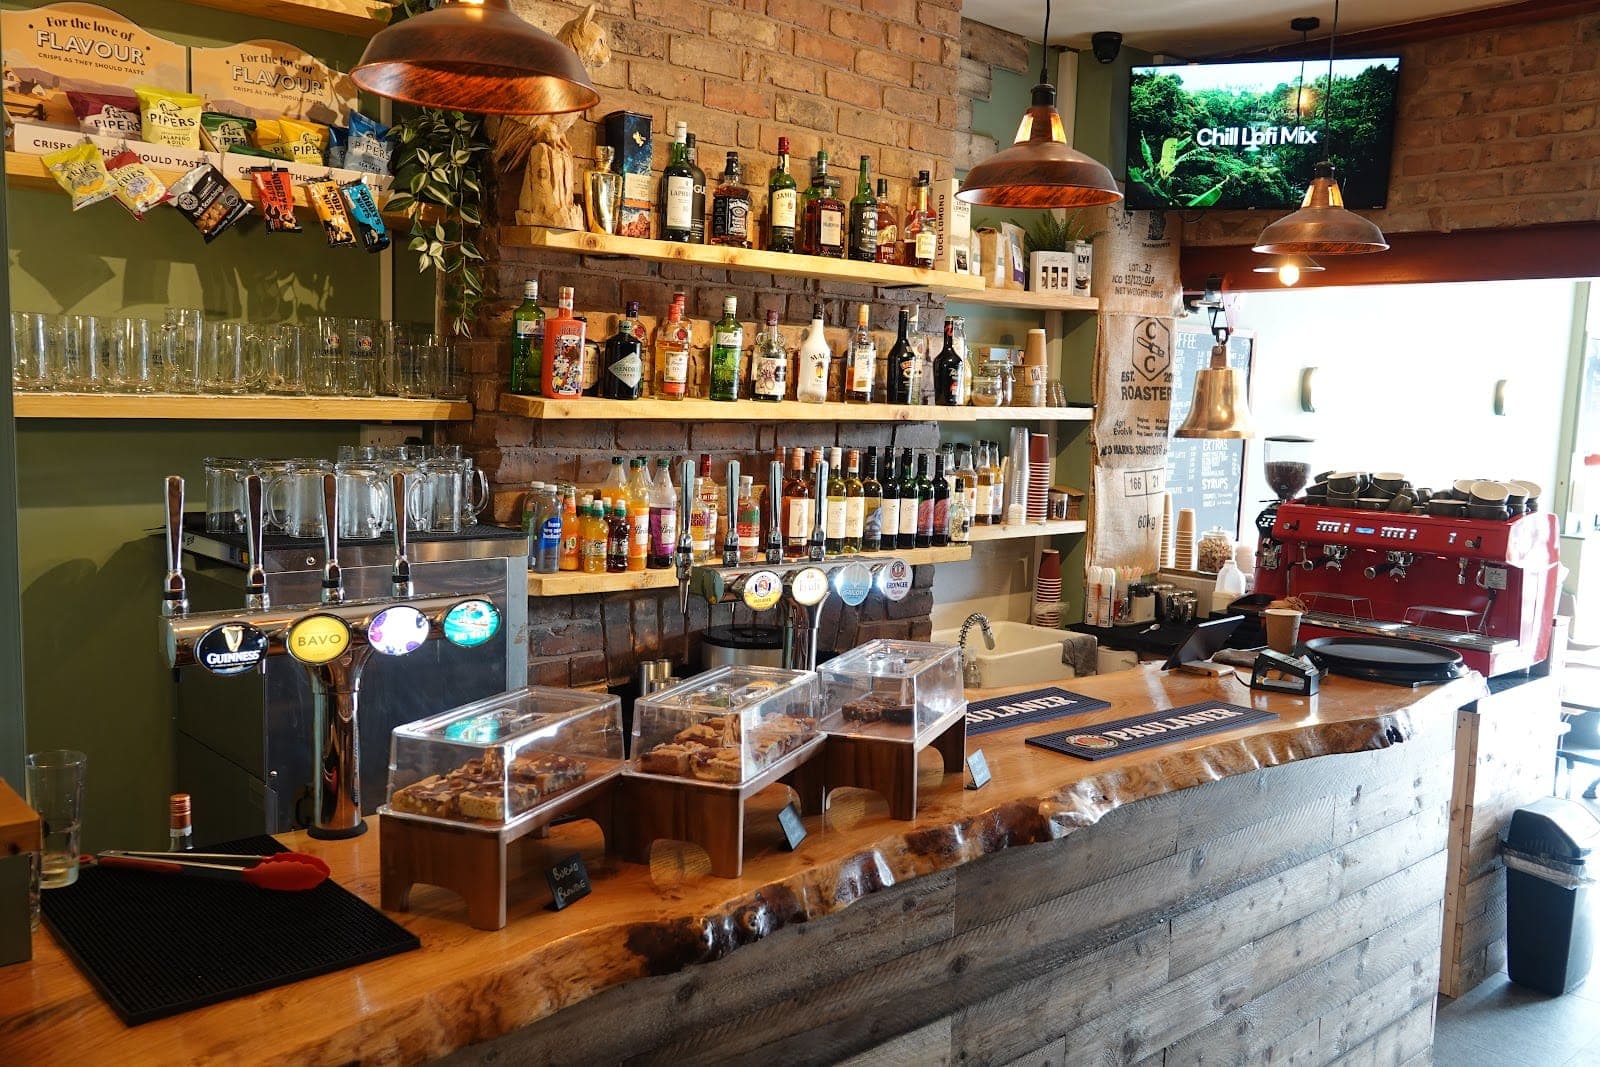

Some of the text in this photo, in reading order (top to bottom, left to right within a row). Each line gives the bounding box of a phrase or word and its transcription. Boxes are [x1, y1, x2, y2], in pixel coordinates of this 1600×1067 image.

[46, 16, 134, 42] For the love of
[37, 30, 145, 66] FLAVOUR
[38, 53, 62, 62] CRISPS
[75, 58, 92, 67] THEY
[95, 62, 122, 72] SHOULD
[124, 67, 144, 76] TASTE
[240, 53, 314, 74] For the love of
[232, 64, 323, 96] FLAVOUR
[94, 120, 142, 132] PIPERS
[150, 113, 195, 128] PIPERS
[1196, 126, 1318, 146] Chill Lofi Mix
[354, 140, 390, 161] PIPERS
[323, 194, 336, 216] NUTS
[1146, 322, 1156, 339] C
[1144, 356, 1156, 373] C
[1121, 372, 1135, 382] EST.
[298, 634, 342, 647] BAVO
[206, 650, 260, 665] GUINNESS
[1102, 708, 1244, 742] PAULANER
